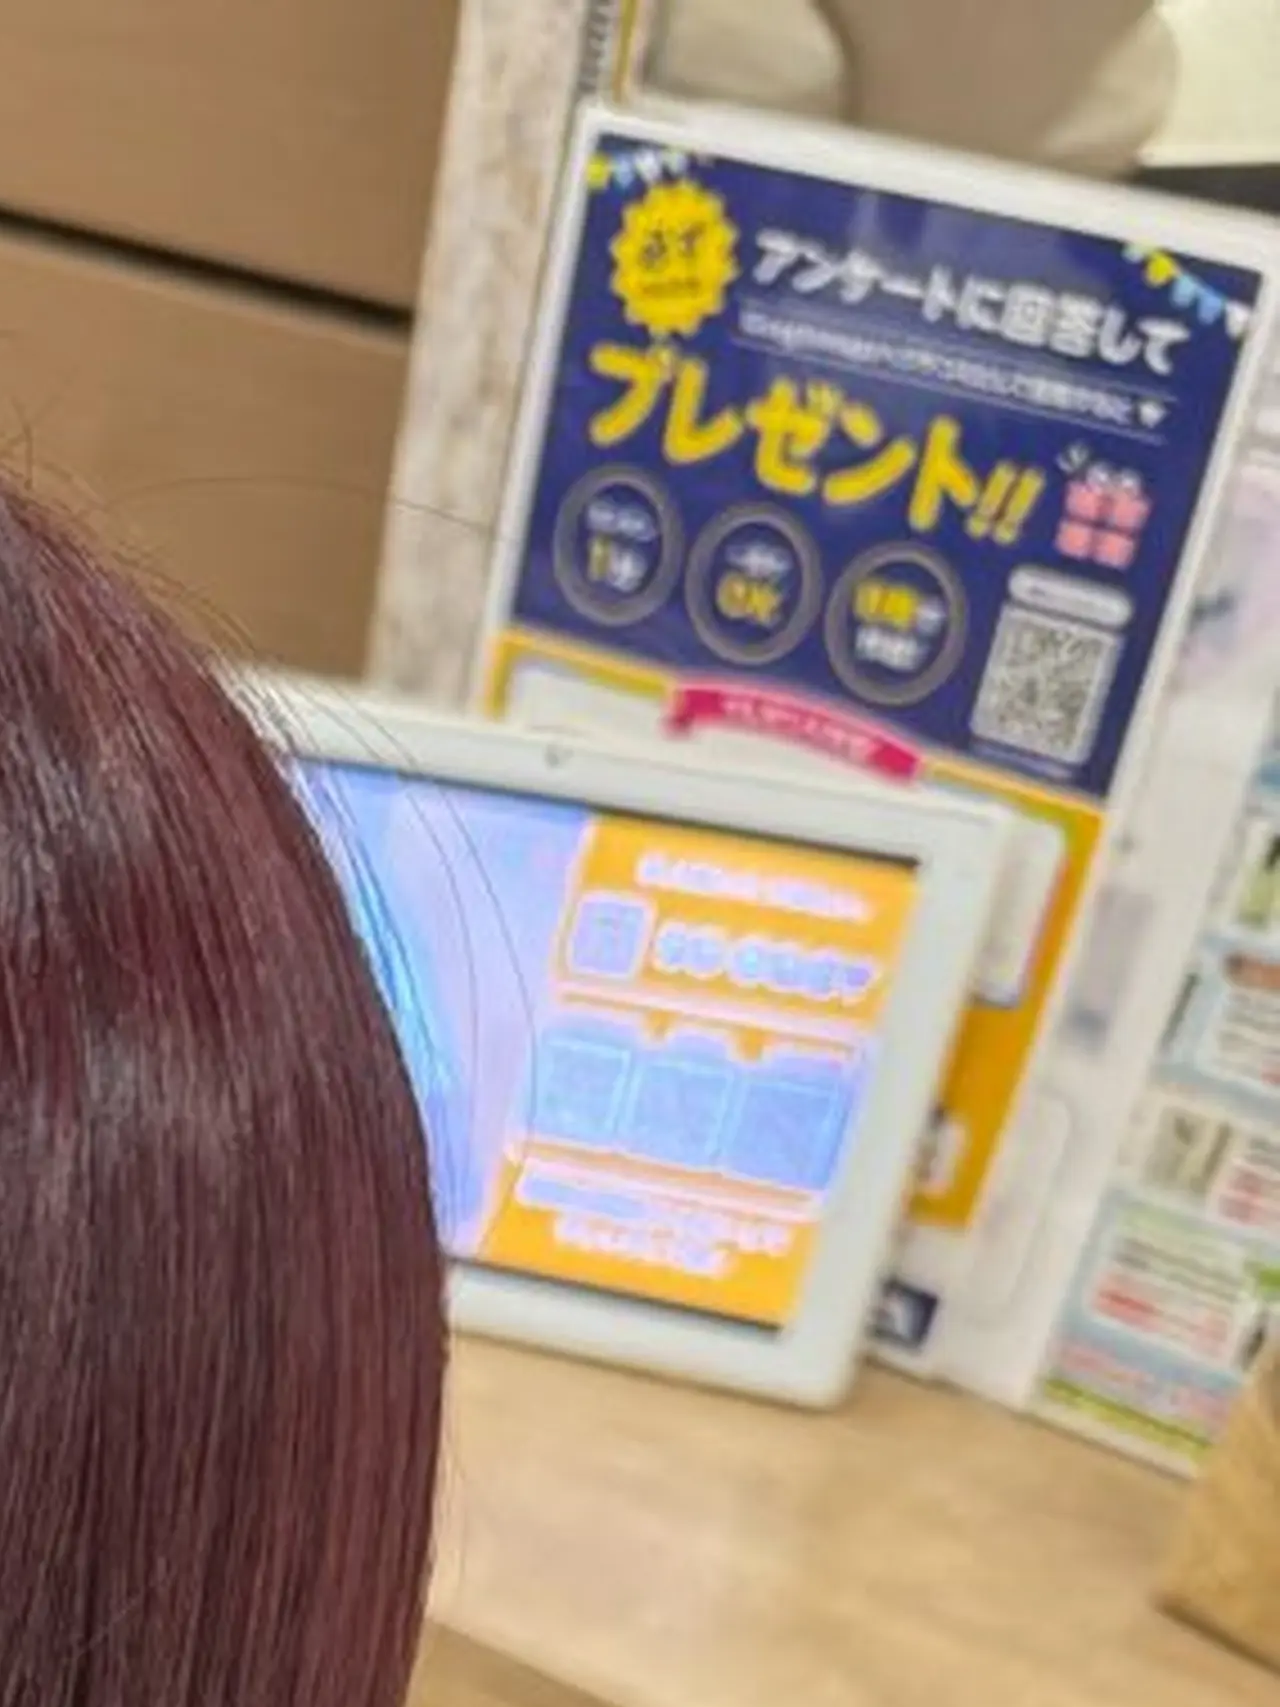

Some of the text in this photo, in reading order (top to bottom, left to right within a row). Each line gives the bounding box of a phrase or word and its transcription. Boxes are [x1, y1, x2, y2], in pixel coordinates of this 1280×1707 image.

[753, 230, 1191, 375] アンケートに回答して
